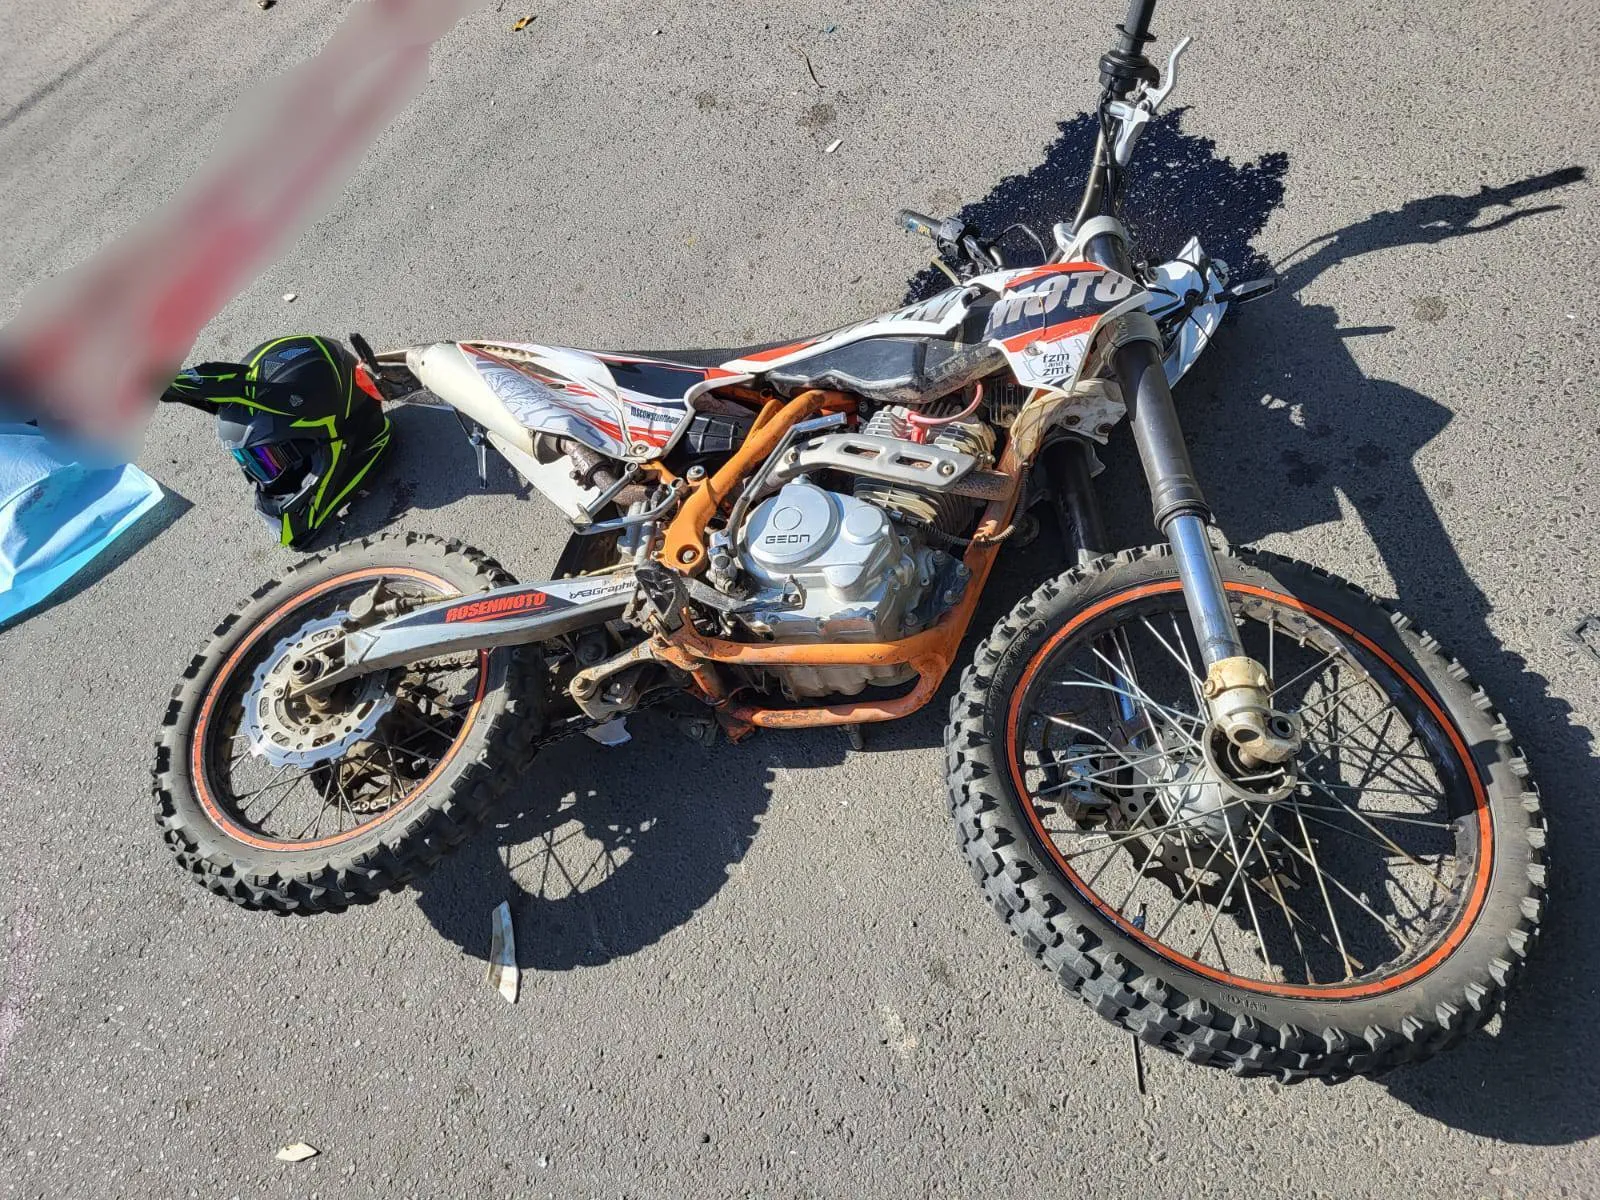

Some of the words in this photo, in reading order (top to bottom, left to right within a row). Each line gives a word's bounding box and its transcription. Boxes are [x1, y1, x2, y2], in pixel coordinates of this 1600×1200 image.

[991, 271, 1133, 329] MOTO
[1042, 364, 1071, 376] zmt
[765, 534, 810, 544] GEON
[445, 592, 546, 624] ROSENMOTO
